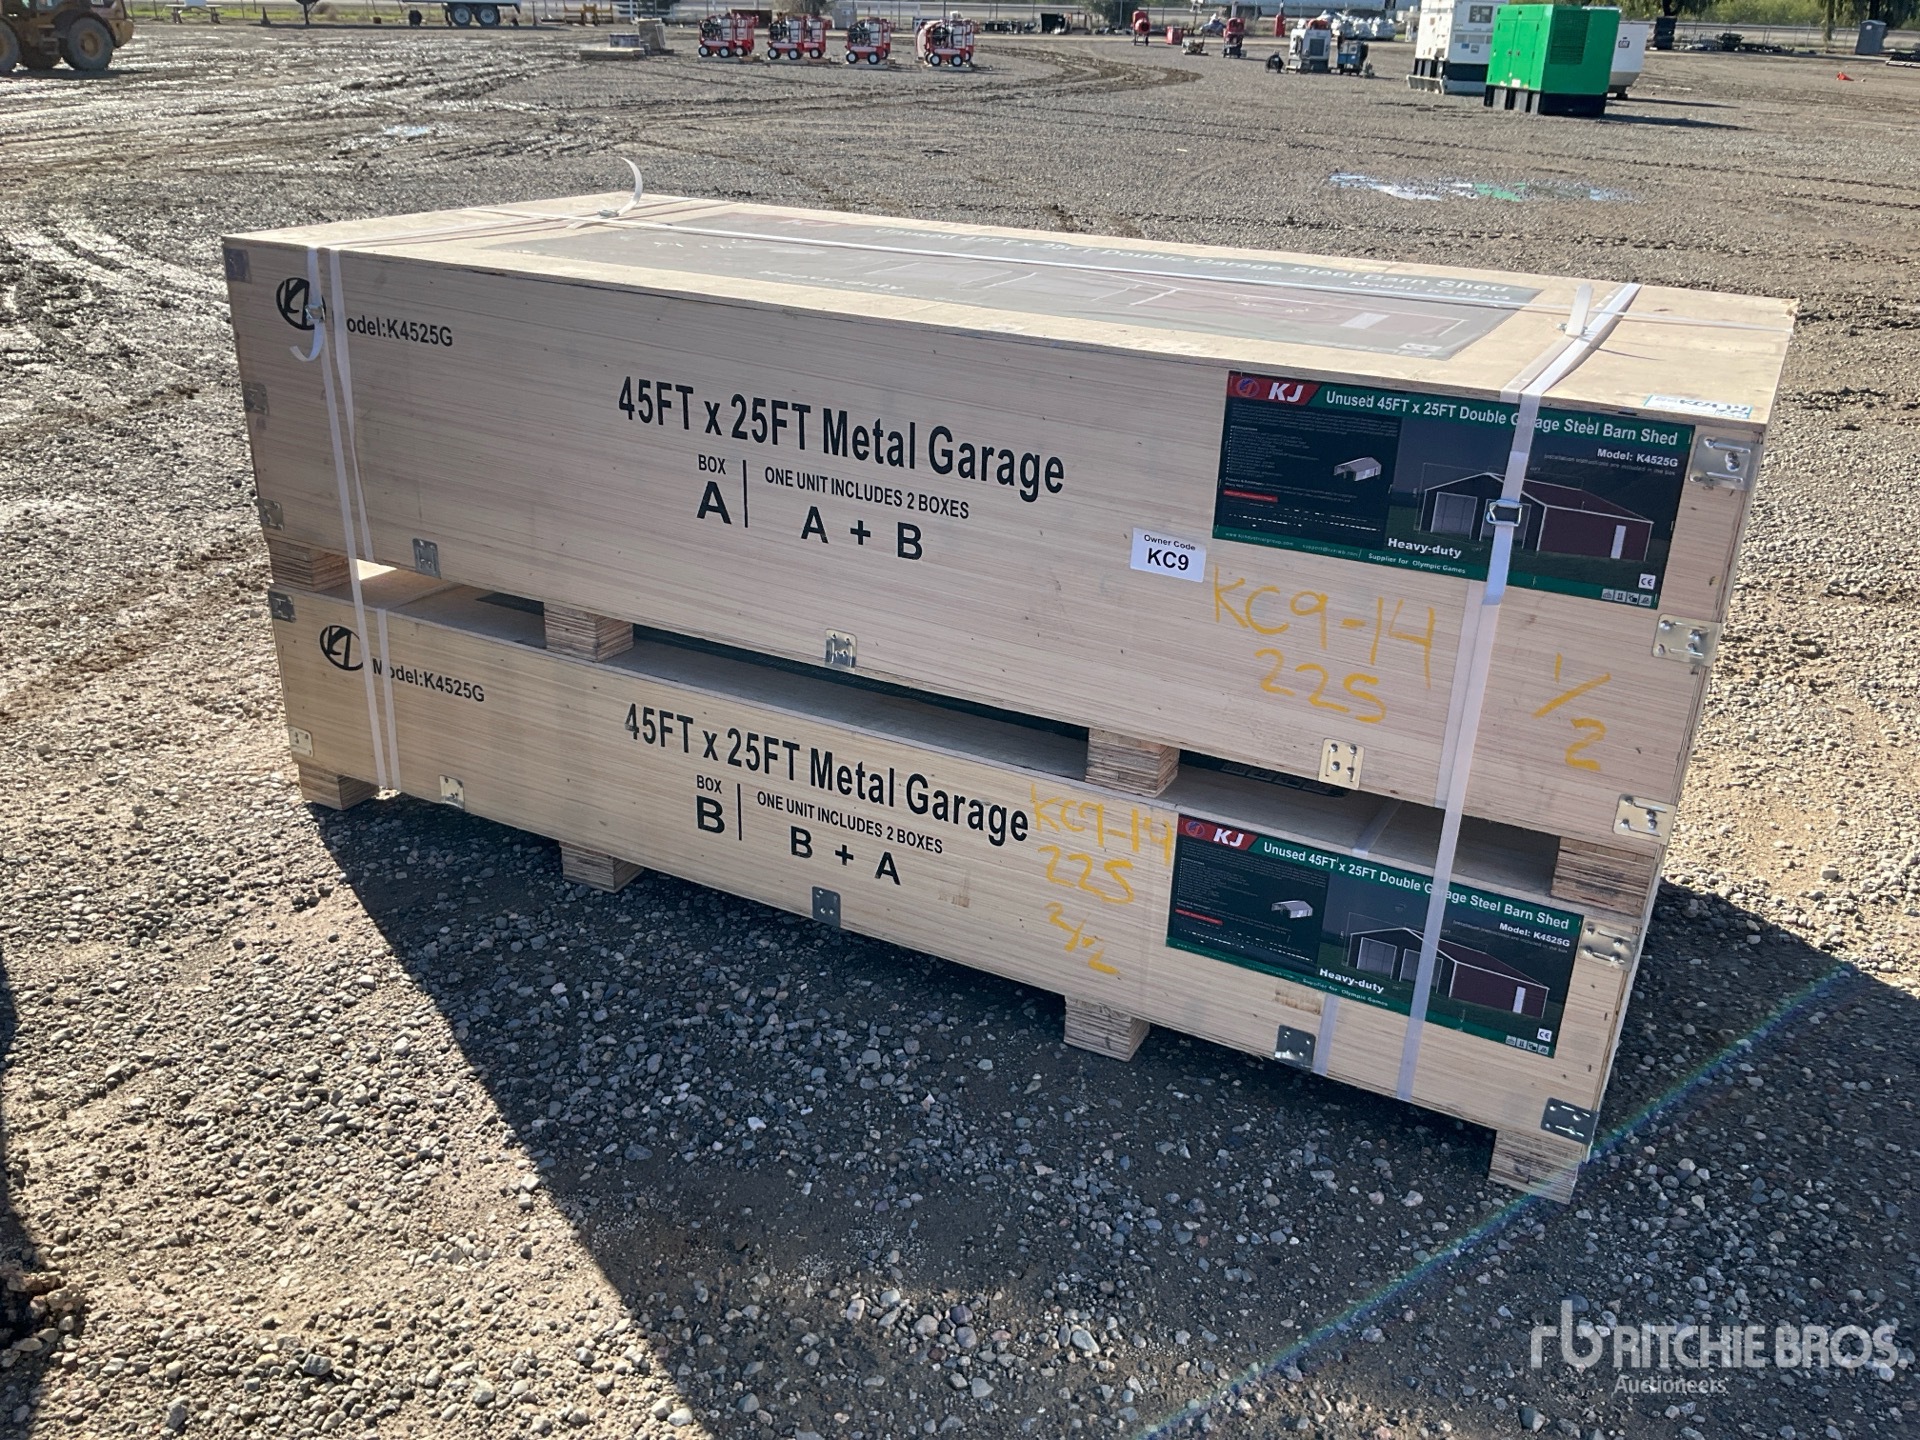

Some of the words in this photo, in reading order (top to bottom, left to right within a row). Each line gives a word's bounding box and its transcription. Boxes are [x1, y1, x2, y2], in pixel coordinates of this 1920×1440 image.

[1101, 248, 1186, 262] Double
[1193, 258, 1282, 272] Garage
[1290, 266, 1356, 279] Steel
[1364, 273, 1427, 285] Barn
[1437, 279, 1510, 292] Shed
[346, 315, 453, 347] odel:K4525G
[1268, 382, 1304, 403] KJ
[1326, 390, 1375, 408] Unused
[1377, 396, 1410, 413] 45FT
[1412, 404, 1420, 414] x
[1423, 402, 1457, 418] 25FT
[1459, 406, 1507, 424] Double
[1511, 412, 1560, 433] Gage
[1563, 418, 1599, 436] Steel
[1603, 423, 1636, 441] Barn
[1640, 427, 1677, 446] Shed
[618, 376, 693, 430] 45FT
[704, 401, 722, 436] x
[731, 393, 811, 451] 25FT
[823, 407, 915, 469] Metal
[928, 425, 1065, 502] Garage
[698, 454, 726, 475] BOX
[1597, 448, 1633, 461] Model:
[1636, 453, 1679, 467] K4525G
[696, 480, 732, 525] A
[765, 466, 793, 487] ONE
[797, 472, 828, 493] UNIT
[831, 477, 903, 507] INCLUDES
[907, 492, 915, 510] 2
[918, 494, 969, 519] BOXES
[801, 505, 829, 544] A
[897, 521, 923, 560] B
[1144, 534, 1171, 546] Owner
[1173, 540, 1196, 551] Code
[1387, 537, 1462, 559] Heavy-duty
[1147, 547, 1189, 571] KC9
[1368, 552, 1396, 565] Supplier
[1398, 557, 1408, 565] for
[1412, 560, 1441, 570] Olympic
[1442, 564, 1466, 574] Games
[1213, 566, 1435, 690] KC9-14
[625, 703, 694, 753] 45FT
[703, 729, 718, 761] x
[727, 727, 800, 781] 25FT
[810, 747, 895, 808] Metal
[906, 773, 1029, 847] Garage
[696, 775, 722, 795] BOX
[696, 795, 726, 834] B
[757, 791, 783, 811] ONE
[786, 798, 815, 819] UNIT
[817, 807, 883, 838] INCLUDES
[887, 826, 894, 841] 2
[897, 828, 943, 854] BOXES
[1213, 828, 1244, 847] KJ
[790, 825, 813, 859] B
[874, 851, 901, 886] A
[1264, 841, 1306, 862] Unused
[1308, 855, 1337, 870] 45FT
[1338, 863, 1345, 872] x
[1348, 863, 1377, 880] 25FT
[1379, 871, 1421, 892] Double
[1424, 882, 1467, 904] Gage
[1469, 894, 1501, 912] Steel
[1503, 903, 1533, 921] Barn
[1536, 911, 1570, 930] Shed
[1499, 922, 1531, 937] Model:
[1533, 931, 1571, 947] K4525G
[1319, 968, 1384, 994] Heavy-duty
